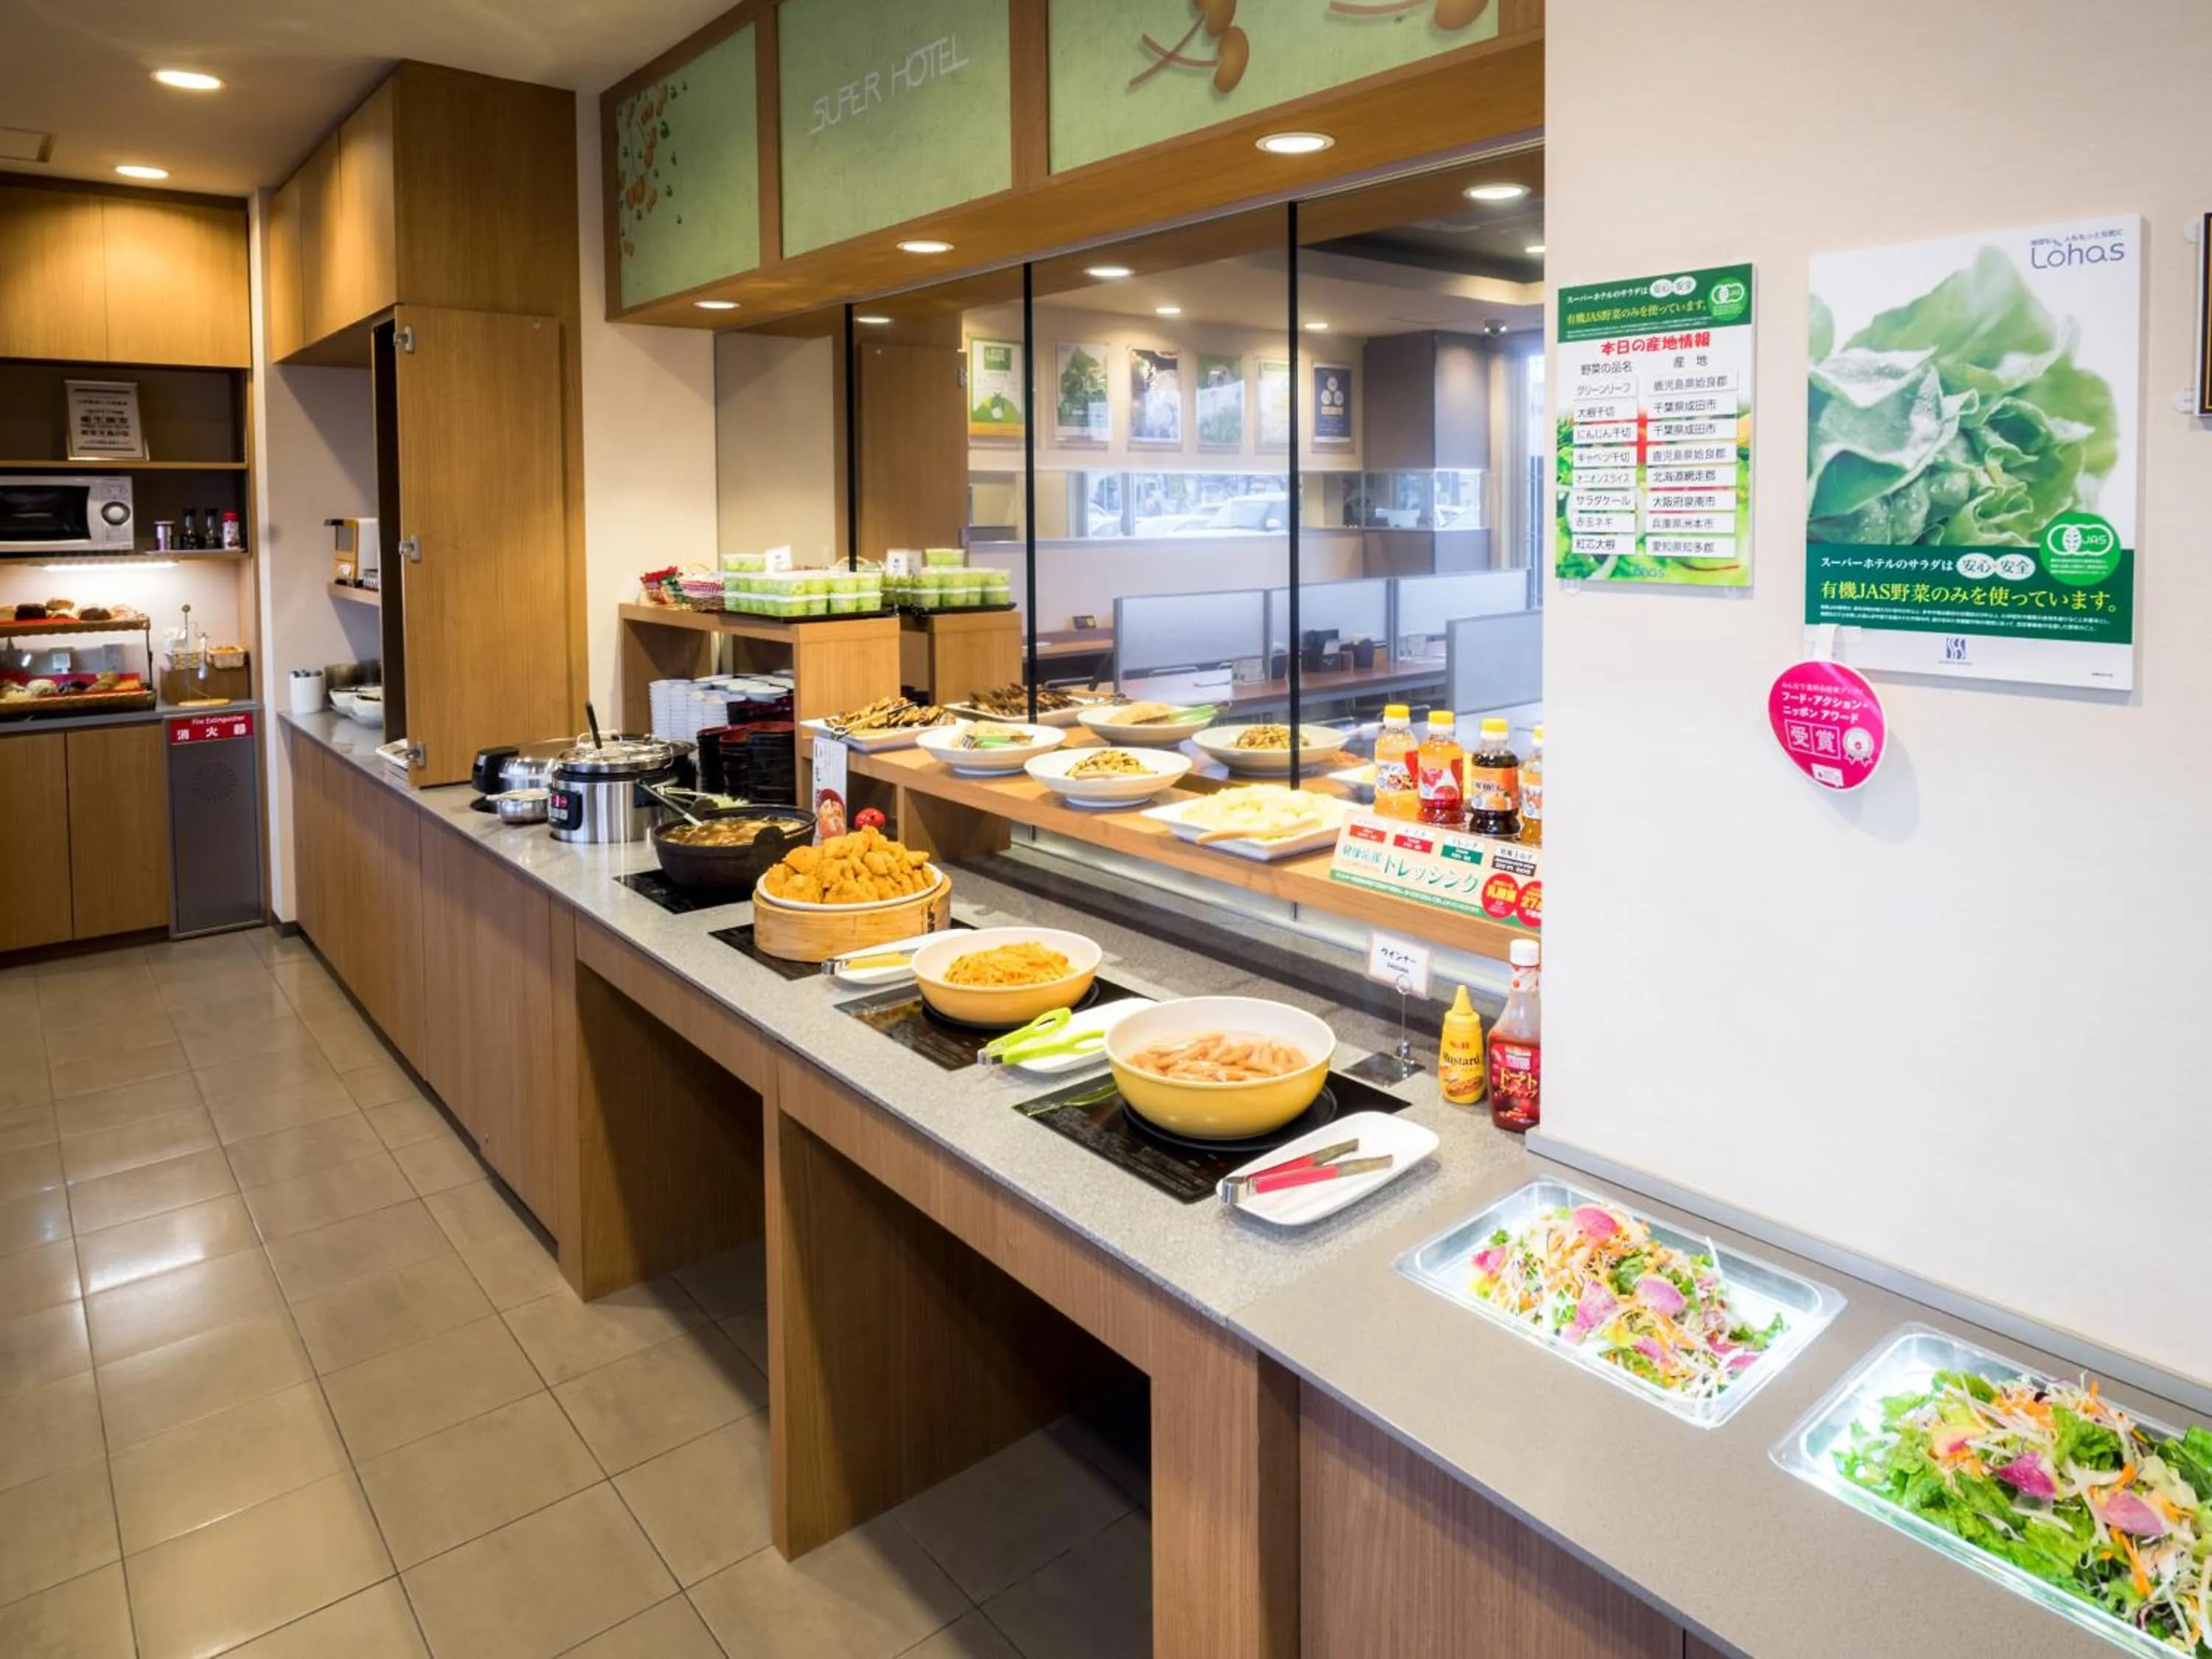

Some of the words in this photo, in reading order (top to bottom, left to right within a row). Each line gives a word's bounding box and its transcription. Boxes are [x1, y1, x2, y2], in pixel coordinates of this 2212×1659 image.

[810, 72, 882, 134] SUPER
[891, 33, 969, 97] HOTEL
[2031, 242, 2124, 269] Lohas
[1601, 332, 1711, 355] 本日の産地情報
[1581, 361, 1632, 375] 野菜の品名
[1576, 383, 1631, 396] グリーンリーフ
[1578, 406, 1615, 418] 大根千切
[1653, 399, 1717, 413] 千葉県成田市
[1577, 427, 1631, 440] にんじん千切
[1653, 423, 1716, 437] 千葉県成田市
[1577, 452, 1630, 463] キャベツ千切
[2081, 535, 2107, 545] JAS
[1820, 557, 1954, 571] スーパーホテルのサラダは
[1962, 559, 1992, 573] 安心
[2000, 560, 2030, 574] 安全
[1820, 580, 2117, 613] 有機JAS野菜のみを使っています。
[1820, 709, 1859, 725] アワード
[177, 723, 246, 740] 消火器
[1790, 725, 1836, 754] 受賞
[1442, 1051, 1480, 1065] Mustard
[1500, 1067, 1538, 1093] トマト
